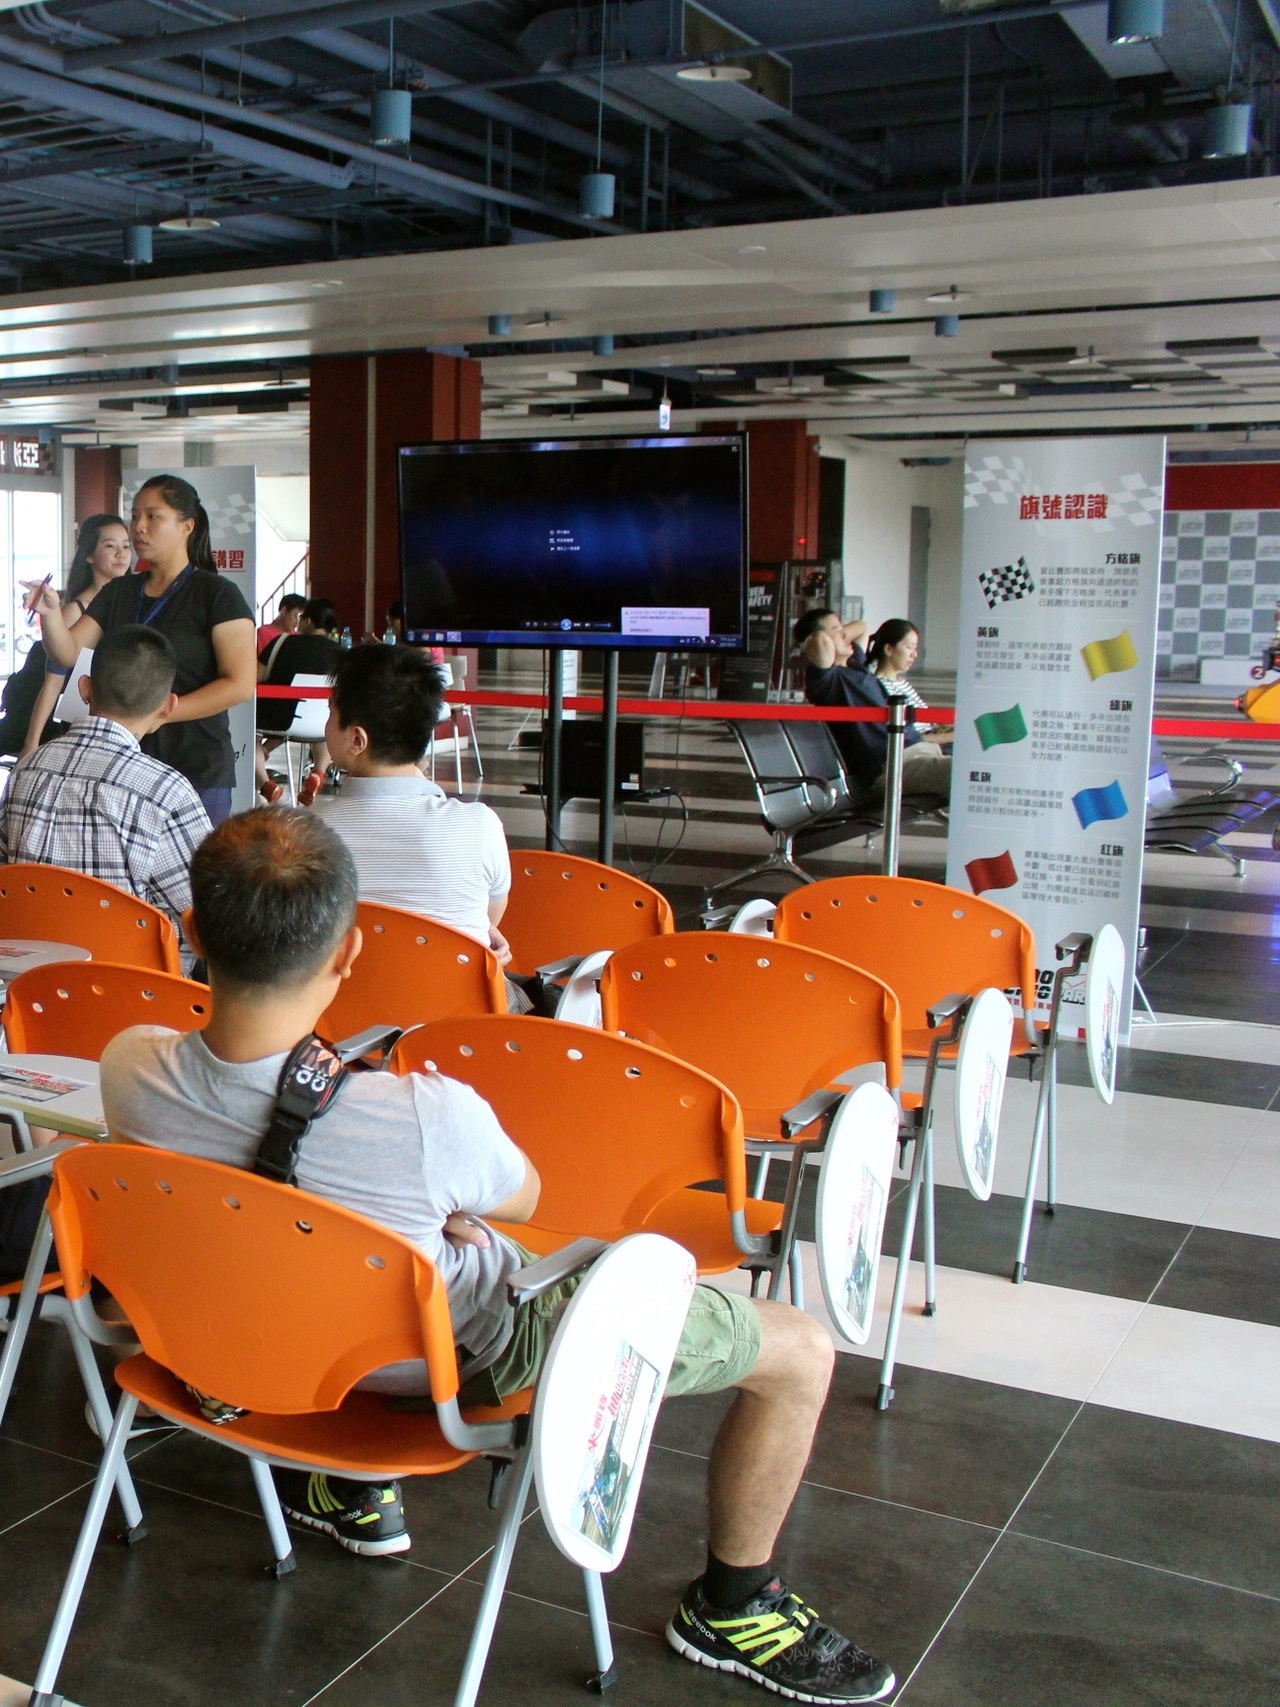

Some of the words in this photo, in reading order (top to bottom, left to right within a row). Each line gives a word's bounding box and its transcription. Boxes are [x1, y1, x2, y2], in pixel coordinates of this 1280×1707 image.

[1019, 494, 1108, 520] 旗號認識
[1105, 553, 1141, 565] 方格旗
[1101, 844, 1124, 856] 紅旗
[688, 1609, 717, 1642] Reebok
